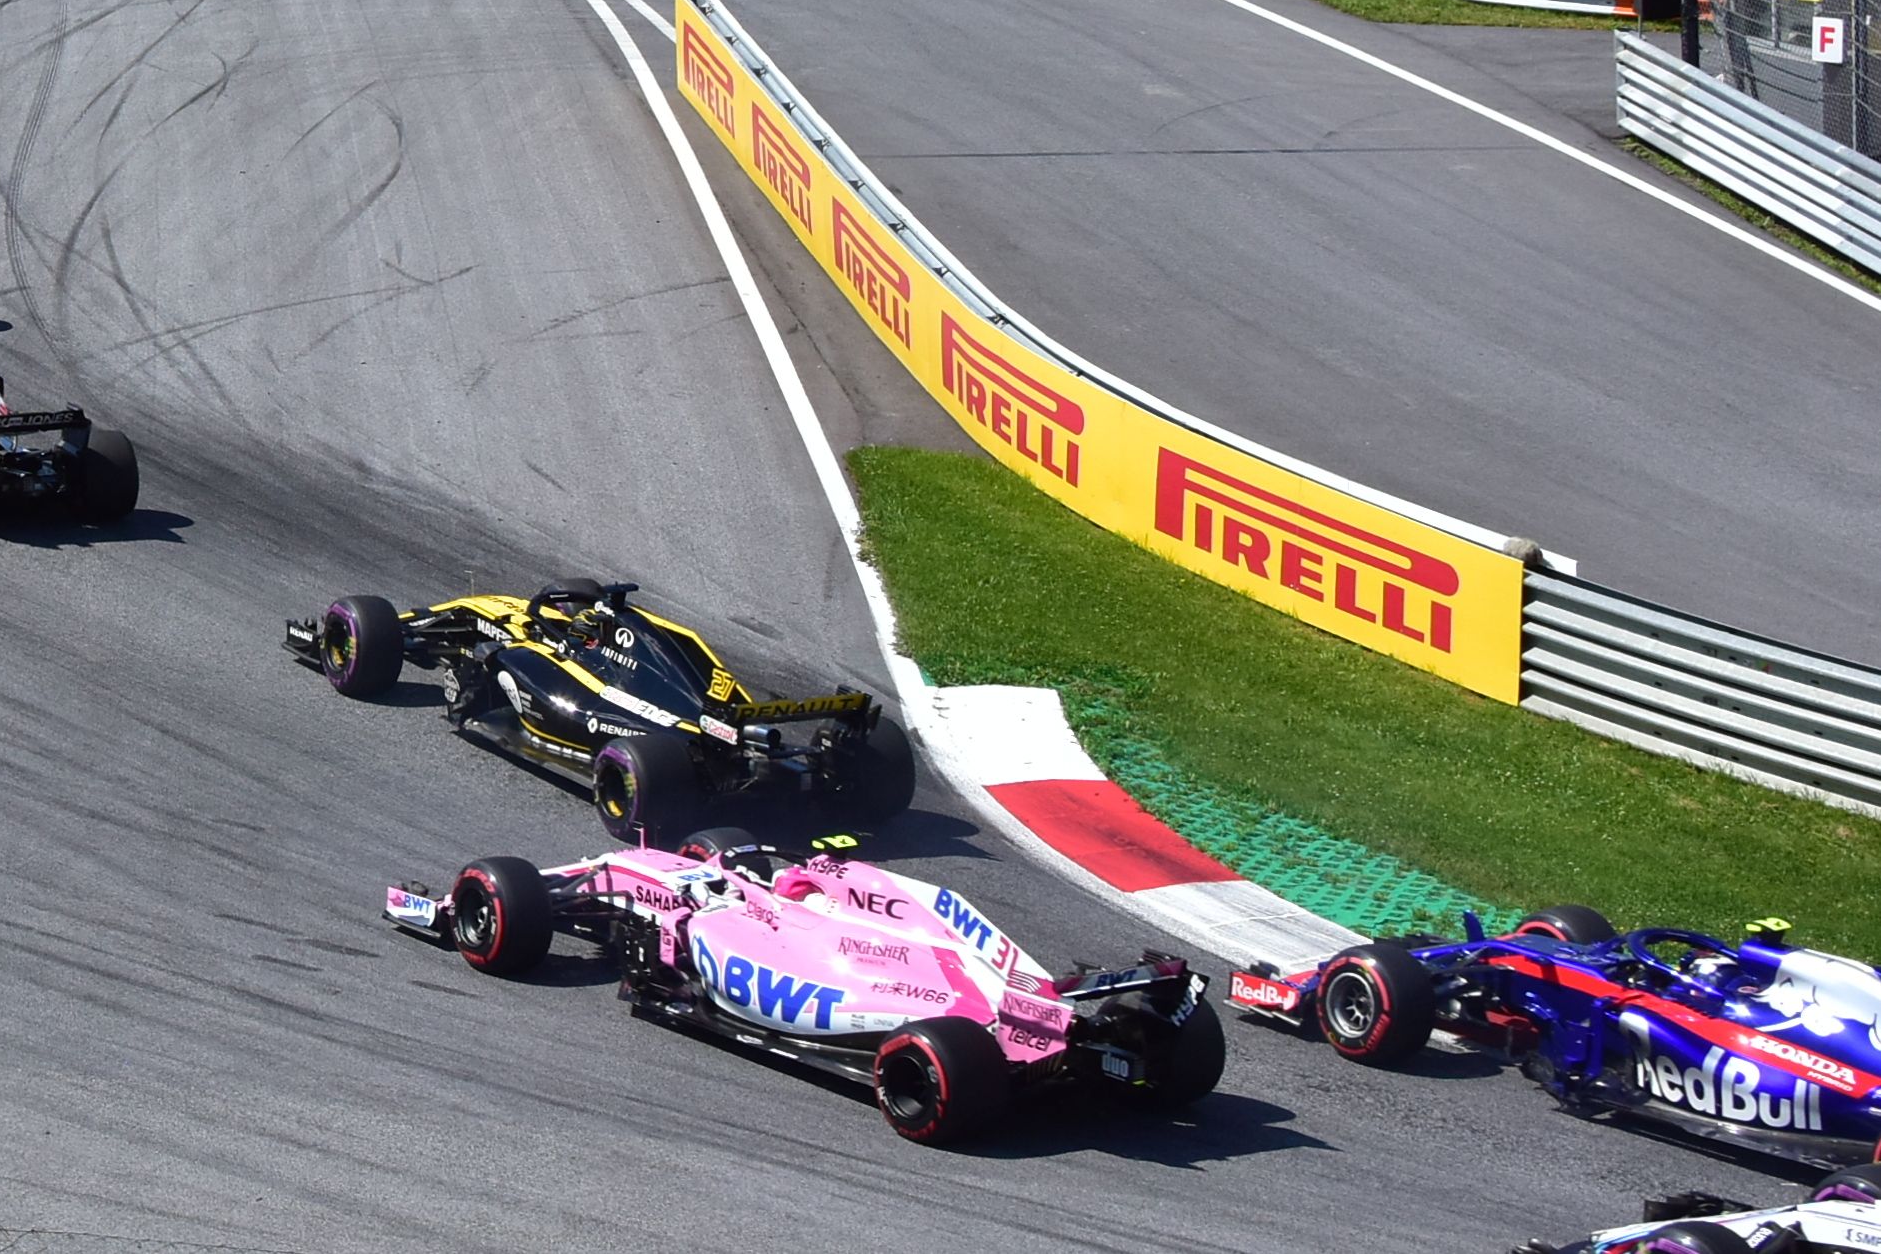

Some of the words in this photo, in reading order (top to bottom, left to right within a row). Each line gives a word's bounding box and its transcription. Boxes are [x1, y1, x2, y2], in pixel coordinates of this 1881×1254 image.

[1819, 26, 1835, 53] F
[683, 21, 735, 140] PIRELLI
[752, 101, 813, 235] PIRELLI
[832, 196, 911, 350] PIRELLI
[941, 310, 1085, 488] PIRELLI
[1154, 446, 1460, 654] PIRELLI
[601, 646, 638, 671] INFINITI
[707, 668, 735, 702] 27
[736, 698, 855, 721] RENAULT
[810, 858, 849, 880] HYPE
[404, 894, 431, 914] BWT
[847, 887, 909, 920] NEC
[933, 887, 993, 950] BWT
[838, 936, 910, 965] KINGFISHER
[991, 934, 1019, 978] 31
[723, 955, 846, 1030] BWT
[1003, 992, 1063, 1029] KINGFISHER
[1750, 1035, 1857, 1084] HONDA
[1807, 1070, 1853, 1092] HYBRID
